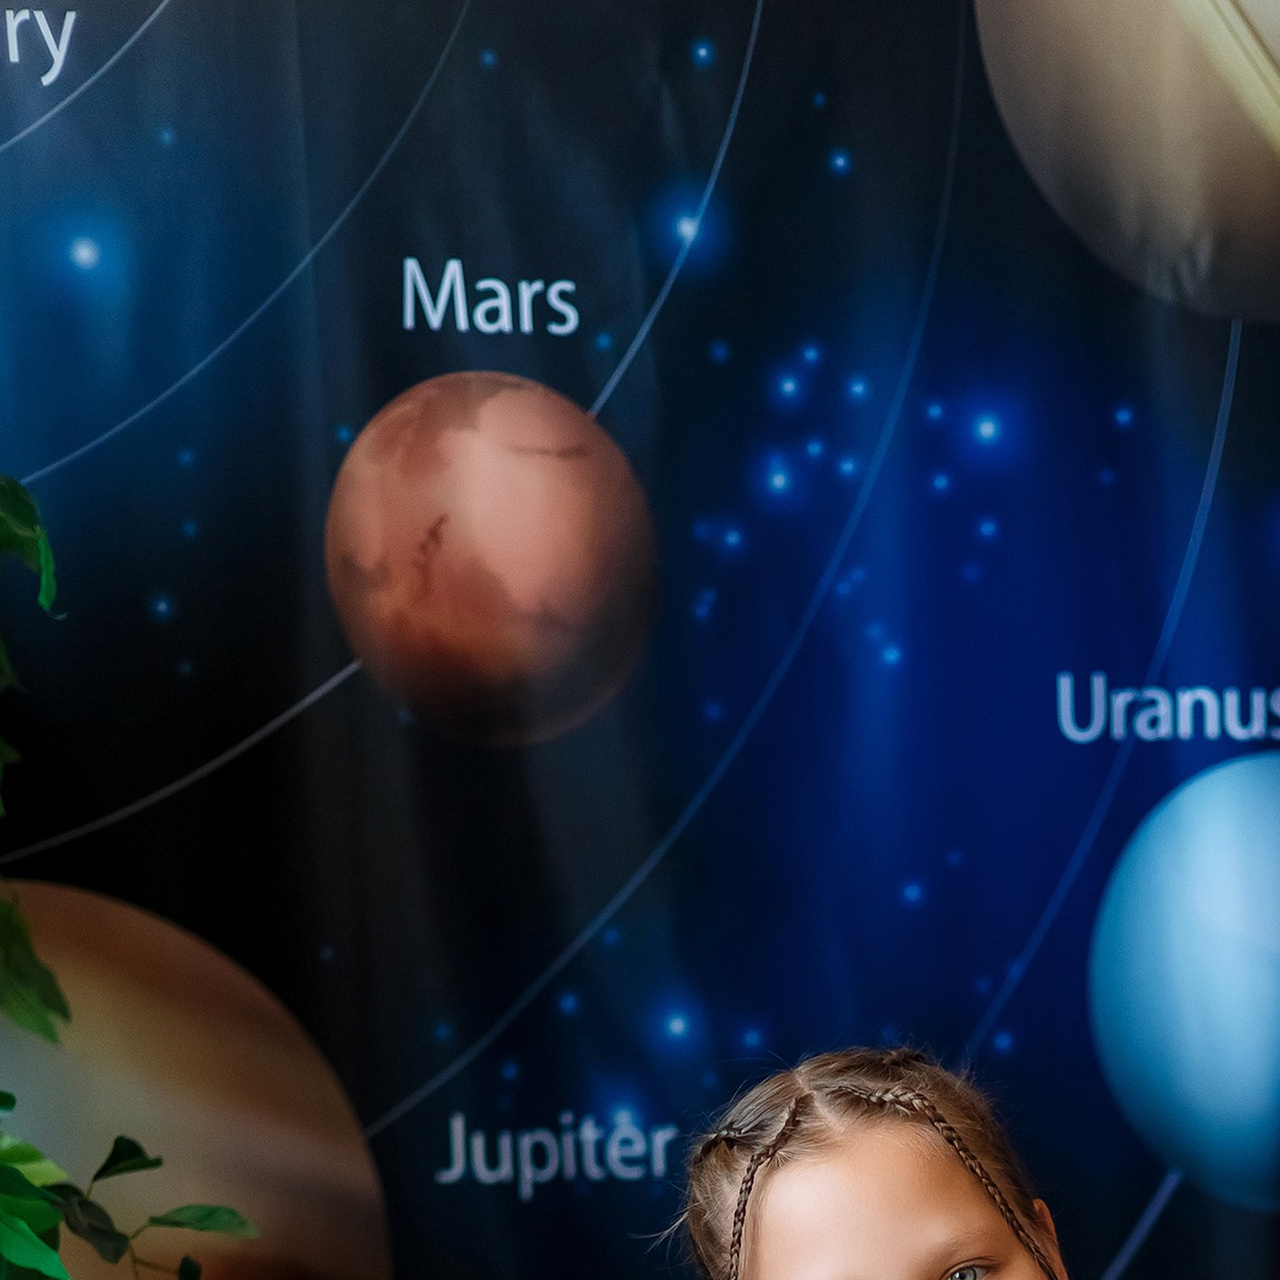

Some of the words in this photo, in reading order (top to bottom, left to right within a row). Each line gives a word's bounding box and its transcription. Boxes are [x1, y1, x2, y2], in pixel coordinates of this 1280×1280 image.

[5, 9, 77, 87] ry
[402, 257, 580, 336] Mars
[435, 1110, 679, 1201] Jupiter
